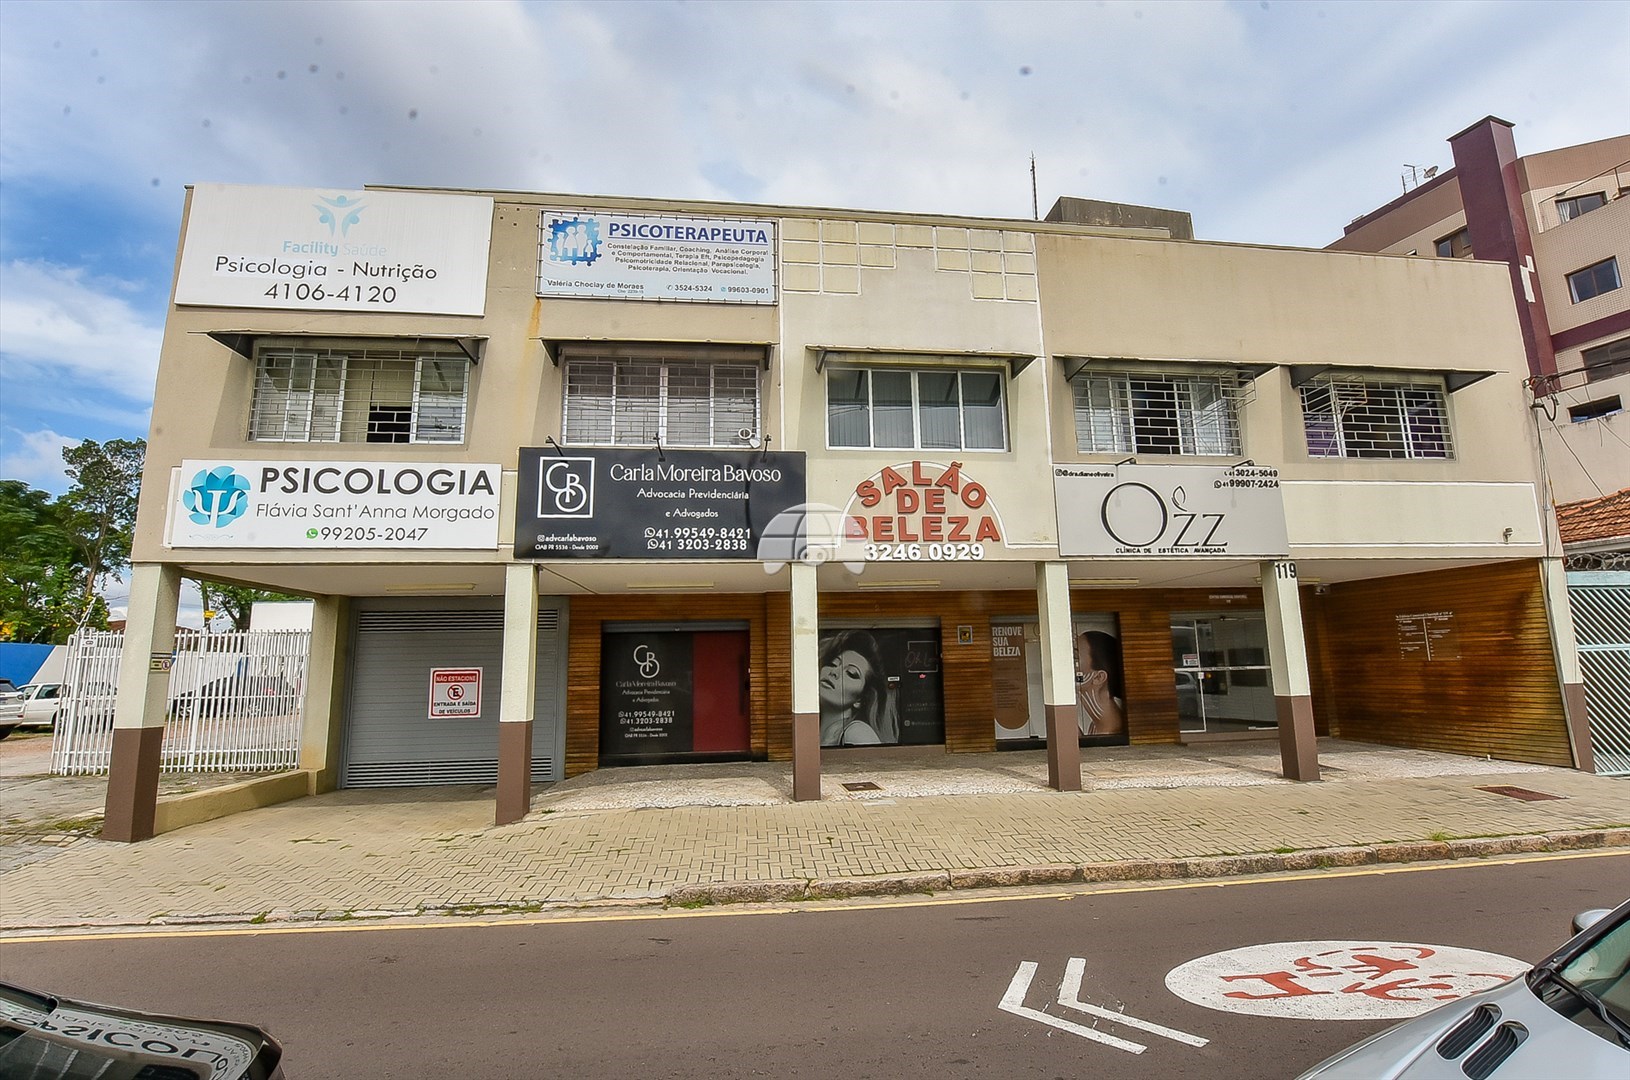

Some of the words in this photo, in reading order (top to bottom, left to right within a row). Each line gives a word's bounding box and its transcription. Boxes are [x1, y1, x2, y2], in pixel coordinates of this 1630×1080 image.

[609, 223, 768, 243] PSICOTERAPEUTA
[282, 240, 339, 257] Facility
[342, 242, 387, 257] Saúde
[607, 242, 648, 251] Constelação
[615, 257, 672, 265] Psicomotricidade
[675, 252, 699, 260] Terapia
[713, 254, 764, 263] Psicopedagogia
[215, 256, 328, 279] Psicologia
[353, 262, 437, 283] Nutrição
[672, 266, 708, 274] Orientação
[547, 279, 573, 287] Valéria
[617, 282, 644, 290] Moraes
[674, 284, 712, 292] 3524-5324
[727, 286, 769, 294] 99603-0901
[264, 283, 397, 304] 4106-4120
[610, 463, 654, 482] Carla
[656, 464, 720, 483] Moreira
[723, 465, 781, 483] Bavoso
[260, 467, 494, 496] PSICOLOGIA
[856, 461, 987, 508] SALÃO
[636, 487, 685, 499] Advocacia
[689, 488, 750, 500] Previdenciária
[896, 489, 946, 514] DE
[256, 503, 309, 519] Flávia
[412, 504, 495, 523] Morgado
[665, 510, 670, 518] e
[673, 508, 719, 519] Advogados
[320, 526, 428, 541] 99205-2047
[655, 527, 751, 540] 41.99549-8421
[845, 516, 1000, 542] BELEZA
[659, 540, 672, 550] 41
[678, 539, 747, 551] 3203-2838
[864, 543, 922, 561] 3246
[928, 543, 984, 561] 0929
[1275, 563, 1297, 579] 119
[992, 626, 1022, 636] RENOVE
[993, 637, 1009, 647] SUA
[993, 647, 1021, 657] BELEZA
